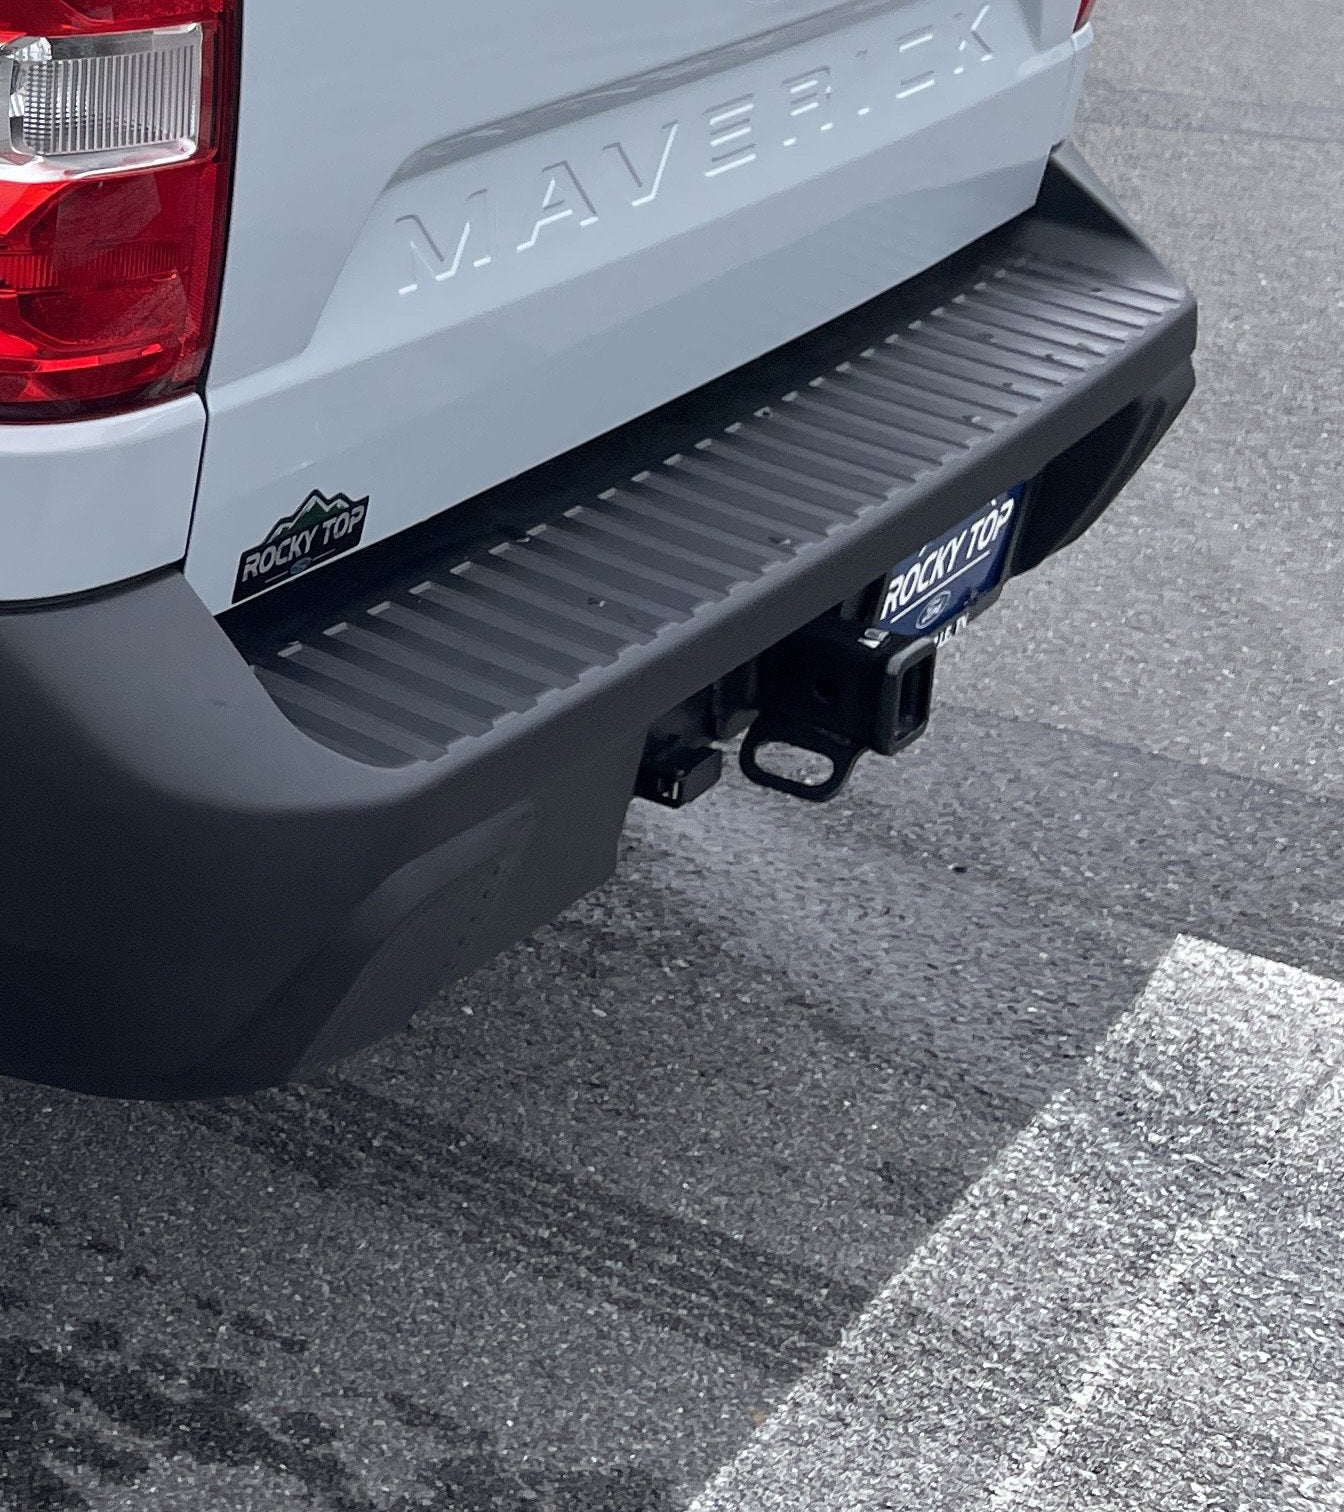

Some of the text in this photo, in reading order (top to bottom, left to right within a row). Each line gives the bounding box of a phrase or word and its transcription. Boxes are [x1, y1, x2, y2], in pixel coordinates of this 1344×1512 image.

[394, 2, 995, 295] MAVERICK
[241, 504, 366, 583] ROCKY TOP
[879, 497, 1015, 621] ROCKY TOP
